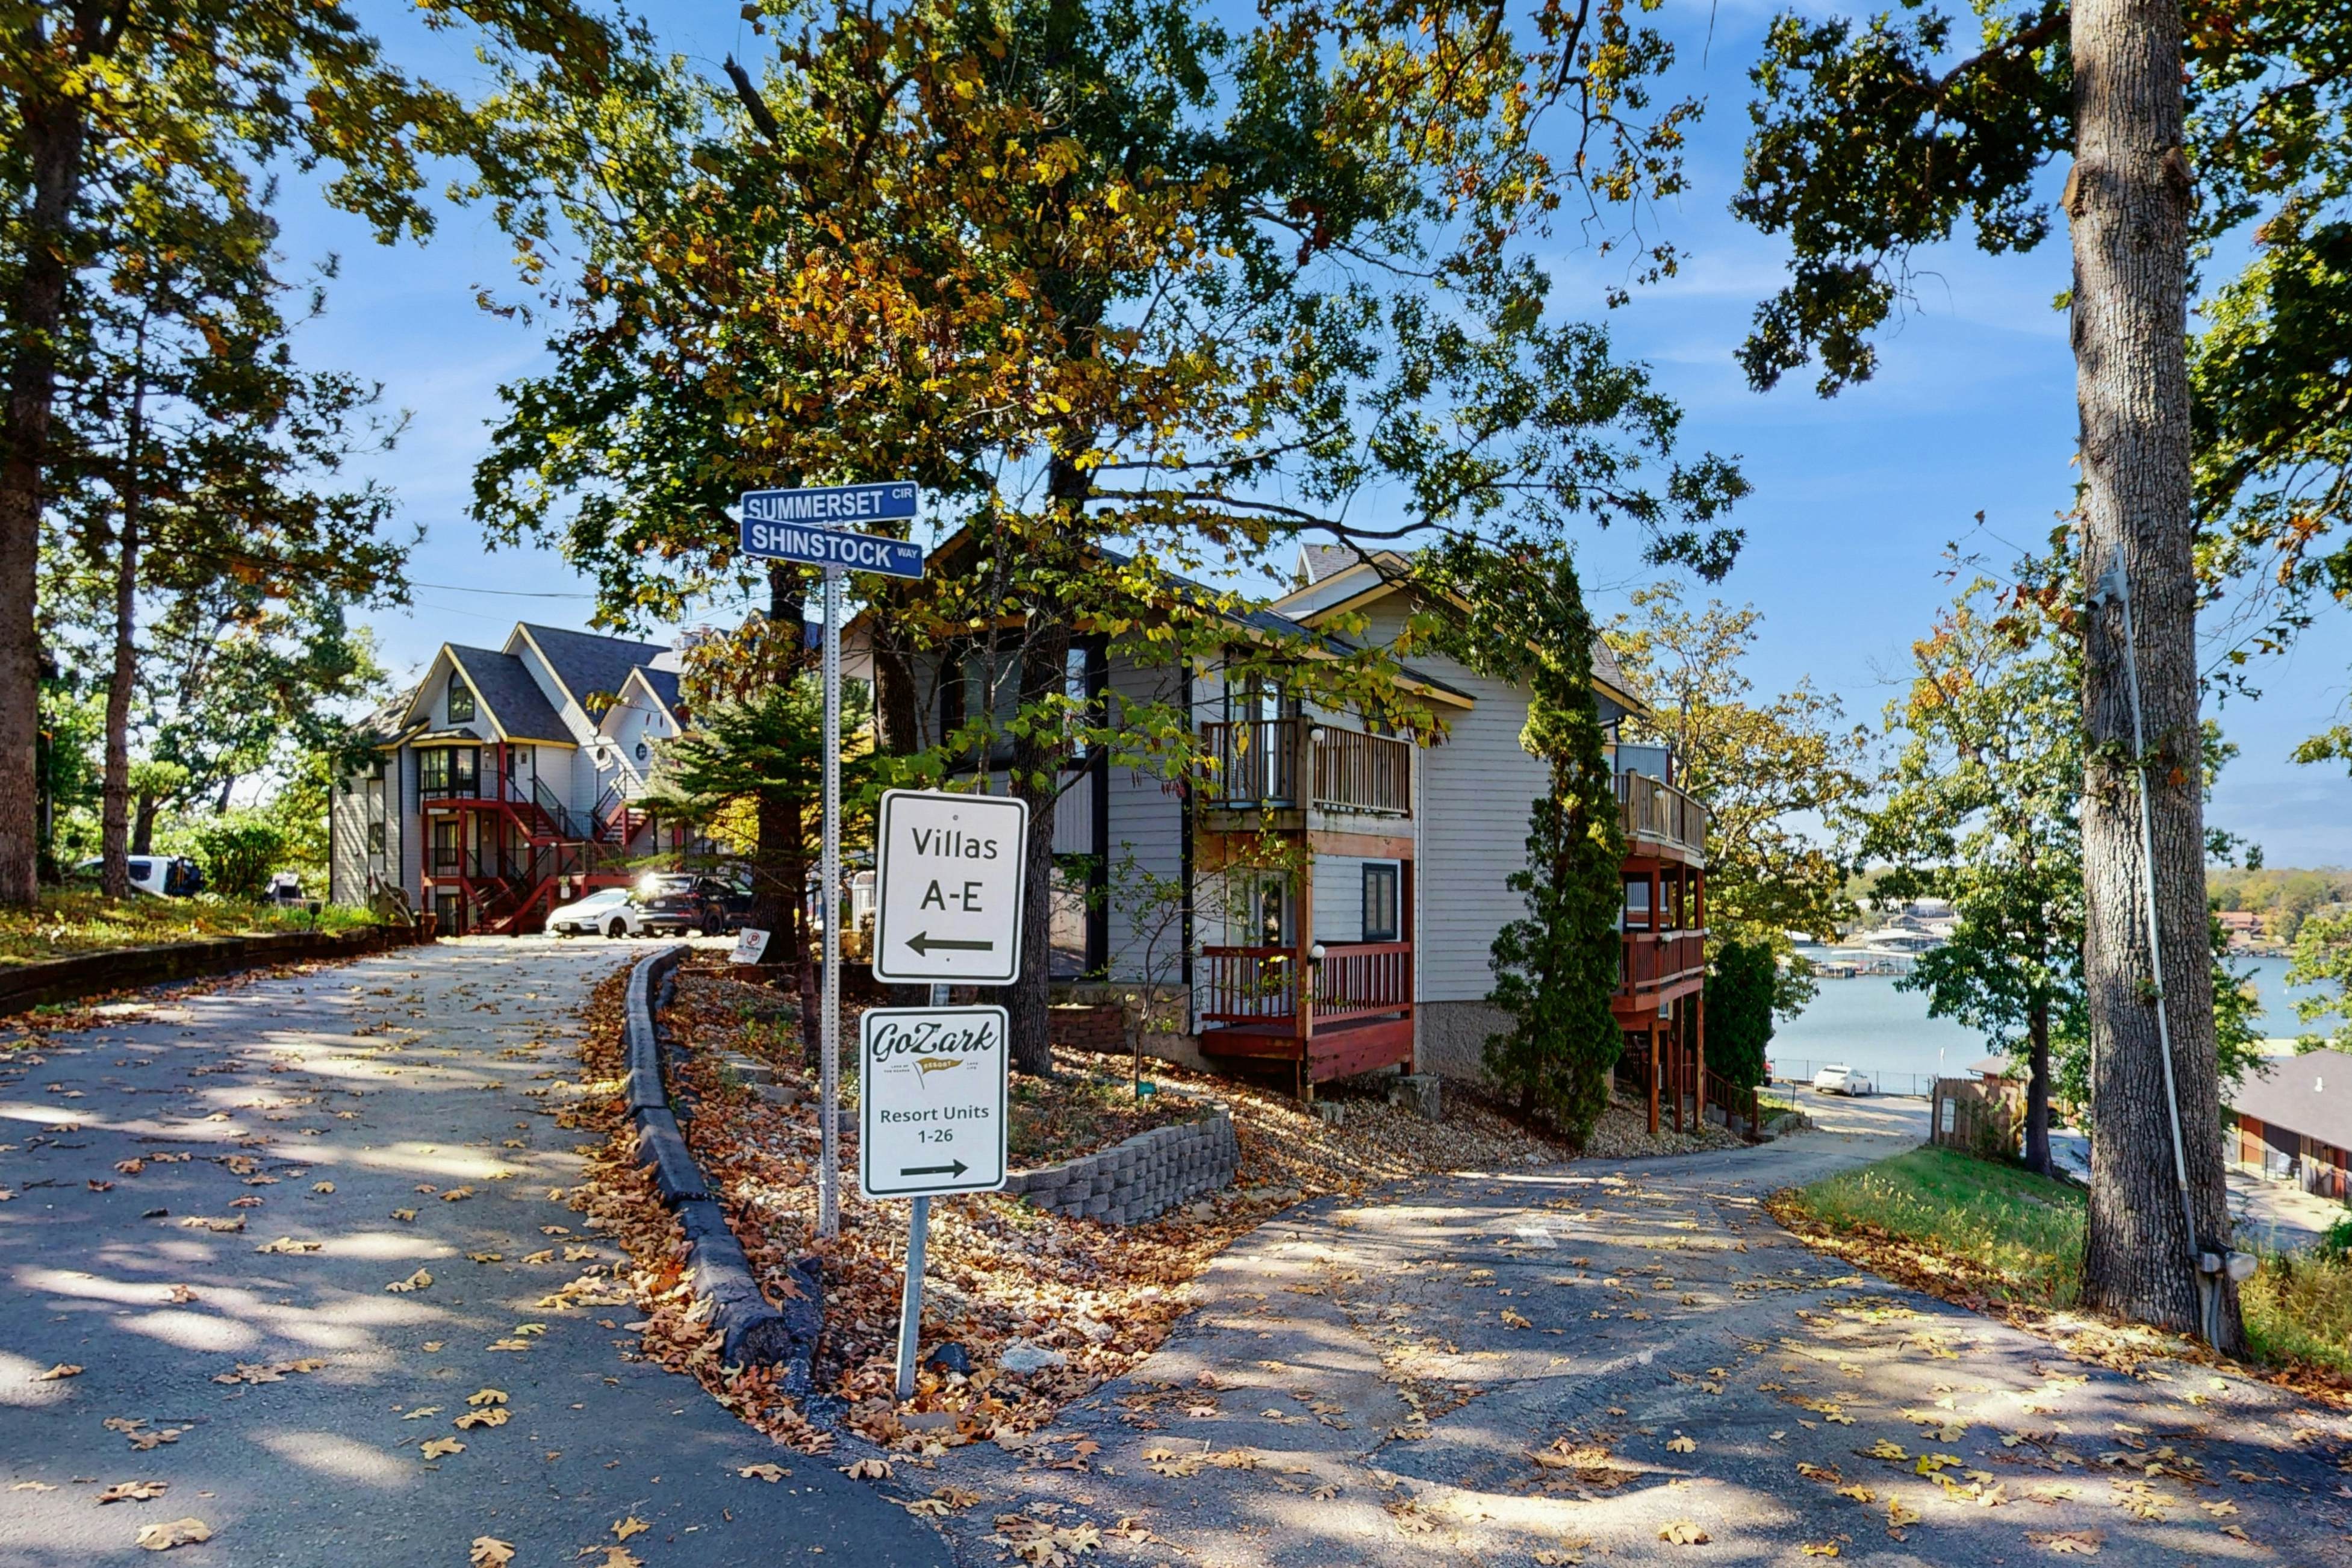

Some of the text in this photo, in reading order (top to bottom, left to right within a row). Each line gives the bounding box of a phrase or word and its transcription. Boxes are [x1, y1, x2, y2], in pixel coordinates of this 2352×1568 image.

[748, 488, 912, 520] SUMMERSET CIR
[752, 524, 918, 568] SHINSTOCK WAY
[912, 827, 997, 860] Villas
[920, 879, 983, 912] A-E
[873, 1021, 998, 1062] GoZark
[923, 1060, 951, 1069] RESORT
[880, 1104, 989, 1123] Resort Units
[918, 1128, 953, 1143] 1-26
